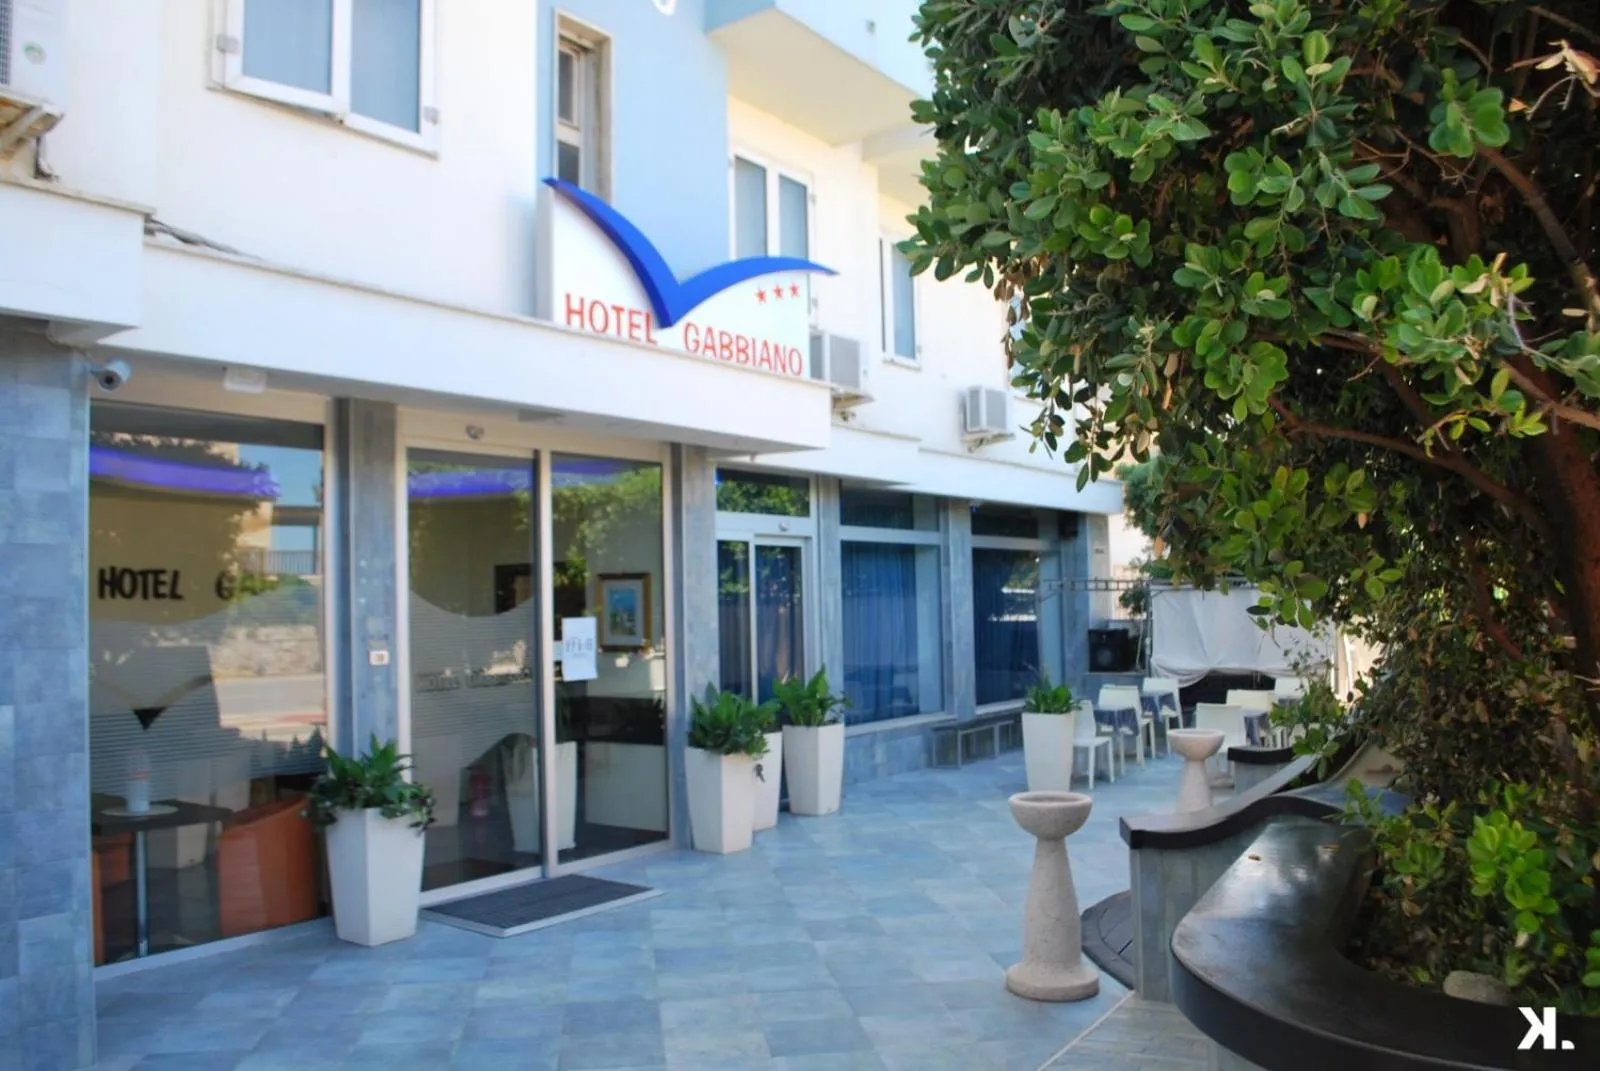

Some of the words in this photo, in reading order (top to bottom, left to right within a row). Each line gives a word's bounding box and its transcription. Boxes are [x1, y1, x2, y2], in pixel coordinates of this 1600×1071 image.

[565, 293, 657, 346] HOTEL
[683, 322, 803, 377] GABBIANO
[97, 566, 184, 601] HOTEL
